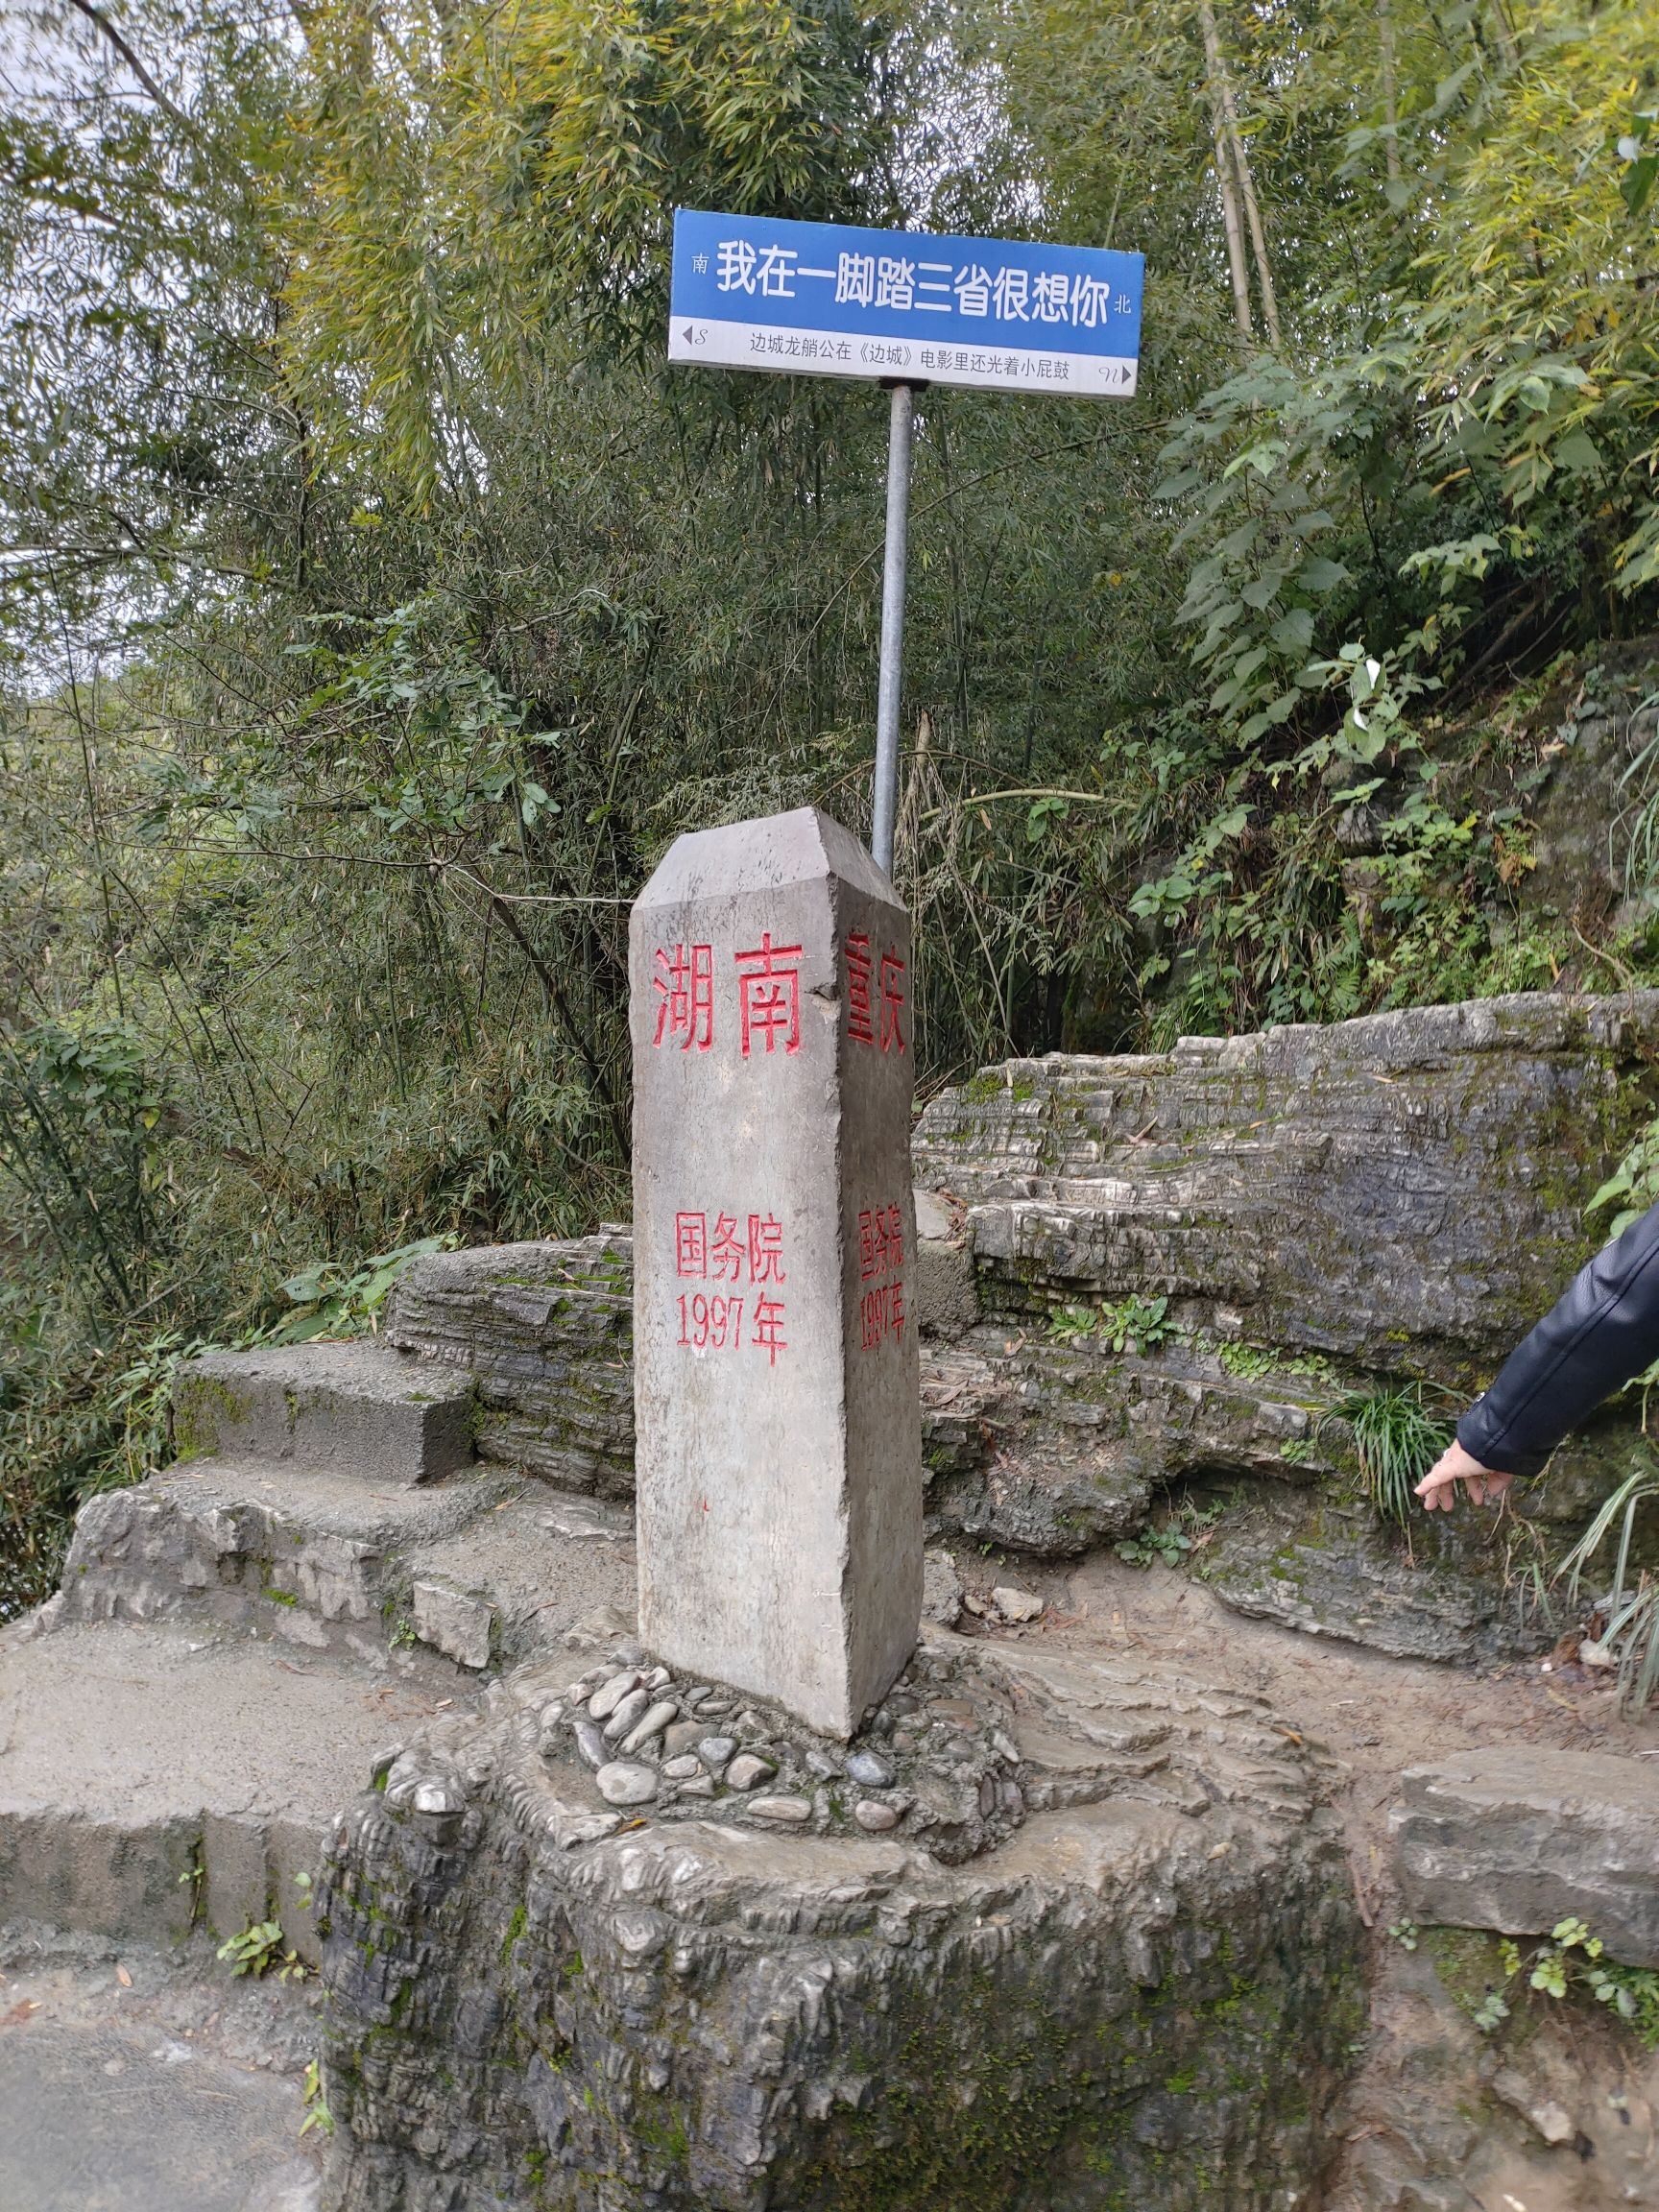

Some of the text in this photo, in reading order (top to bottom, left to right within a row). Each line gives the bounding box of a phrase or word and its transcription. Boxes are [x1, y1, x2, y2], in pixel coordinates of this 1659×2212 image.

[691, 239, 1132, 328] 南 我在一脚踏三省很想你 北
[694, 328, 709, 346] S
[652, 931, 805, 1060] 湖南
[844, 932, 906, 1055] 重庆
[675, 1212, 787, 1286] 国务院
[676, 1290, 788, 1368] 1997年
